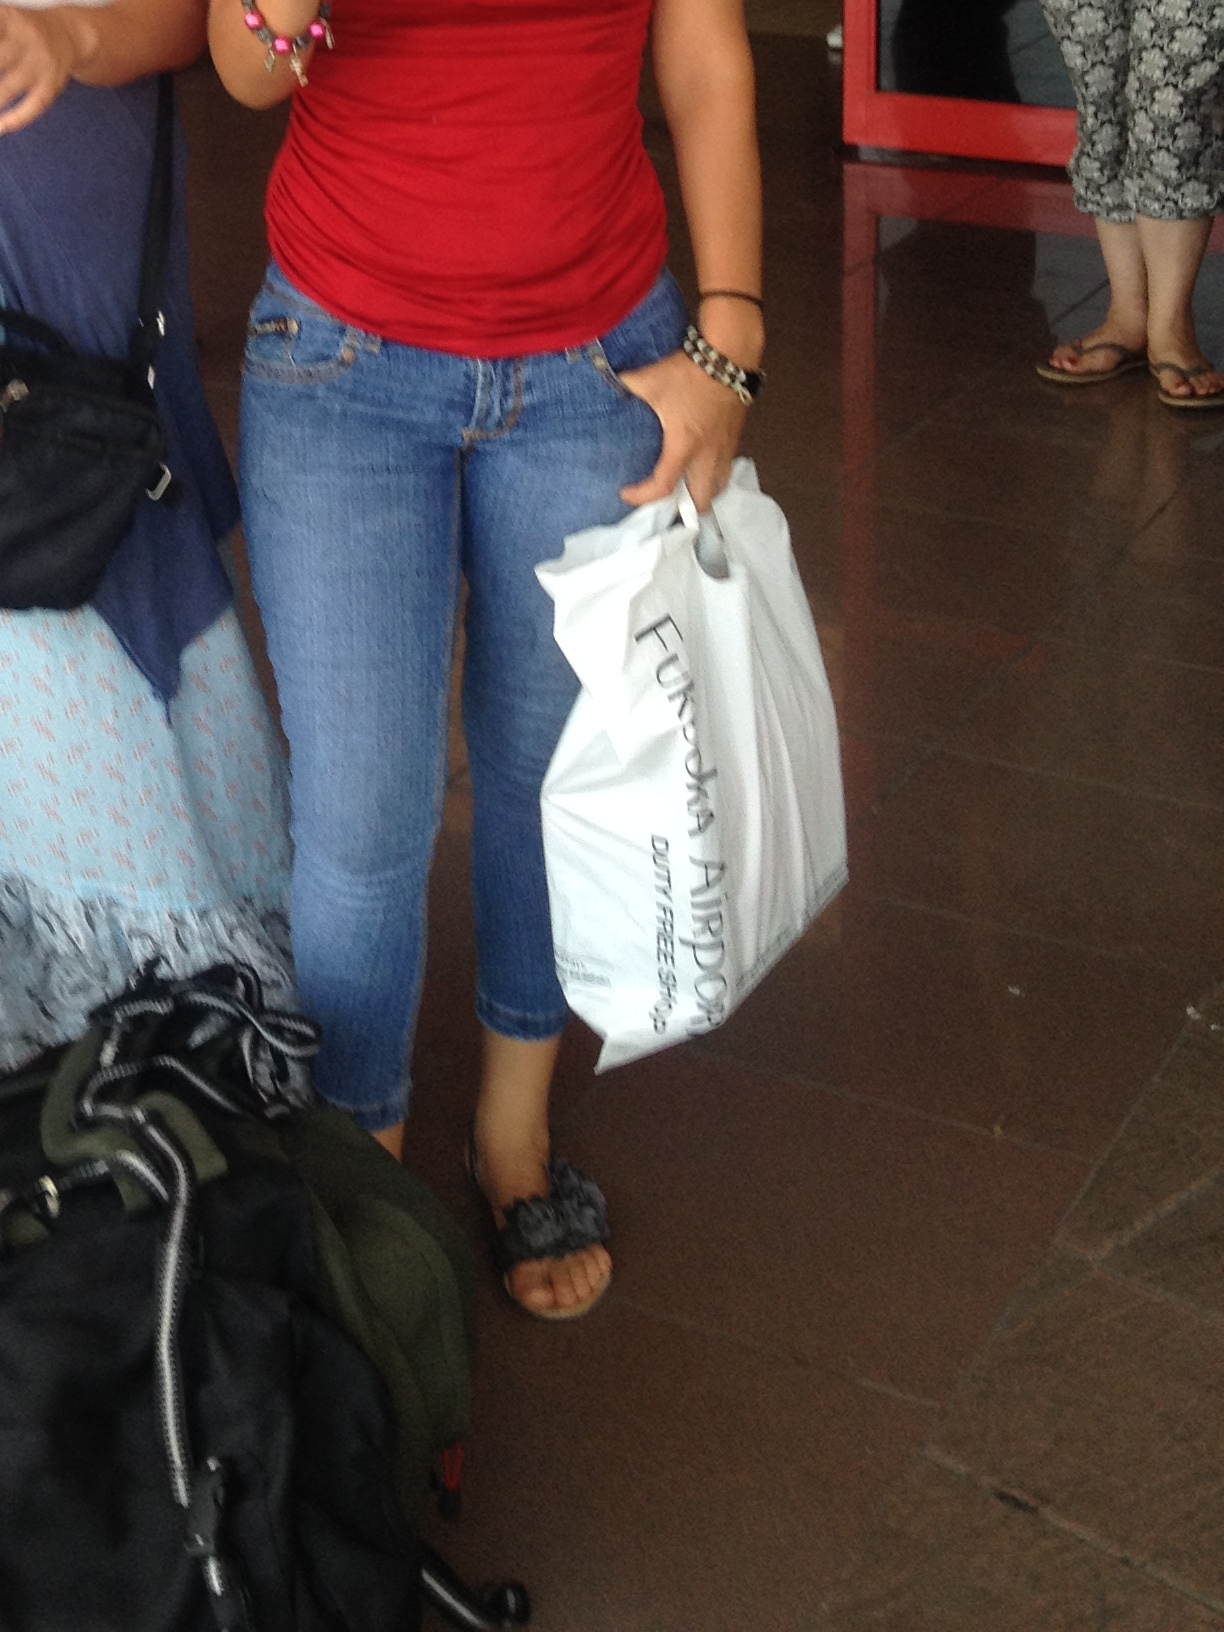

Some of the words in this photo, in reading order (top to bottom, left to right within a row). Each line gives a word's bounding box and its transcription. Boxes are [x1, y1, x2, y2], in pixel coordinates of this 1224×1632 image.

[651, 834, 673, 902] DUTY
[656, 901, 676, 968] FREE
[648, 968, 678, 1035] SHOP
